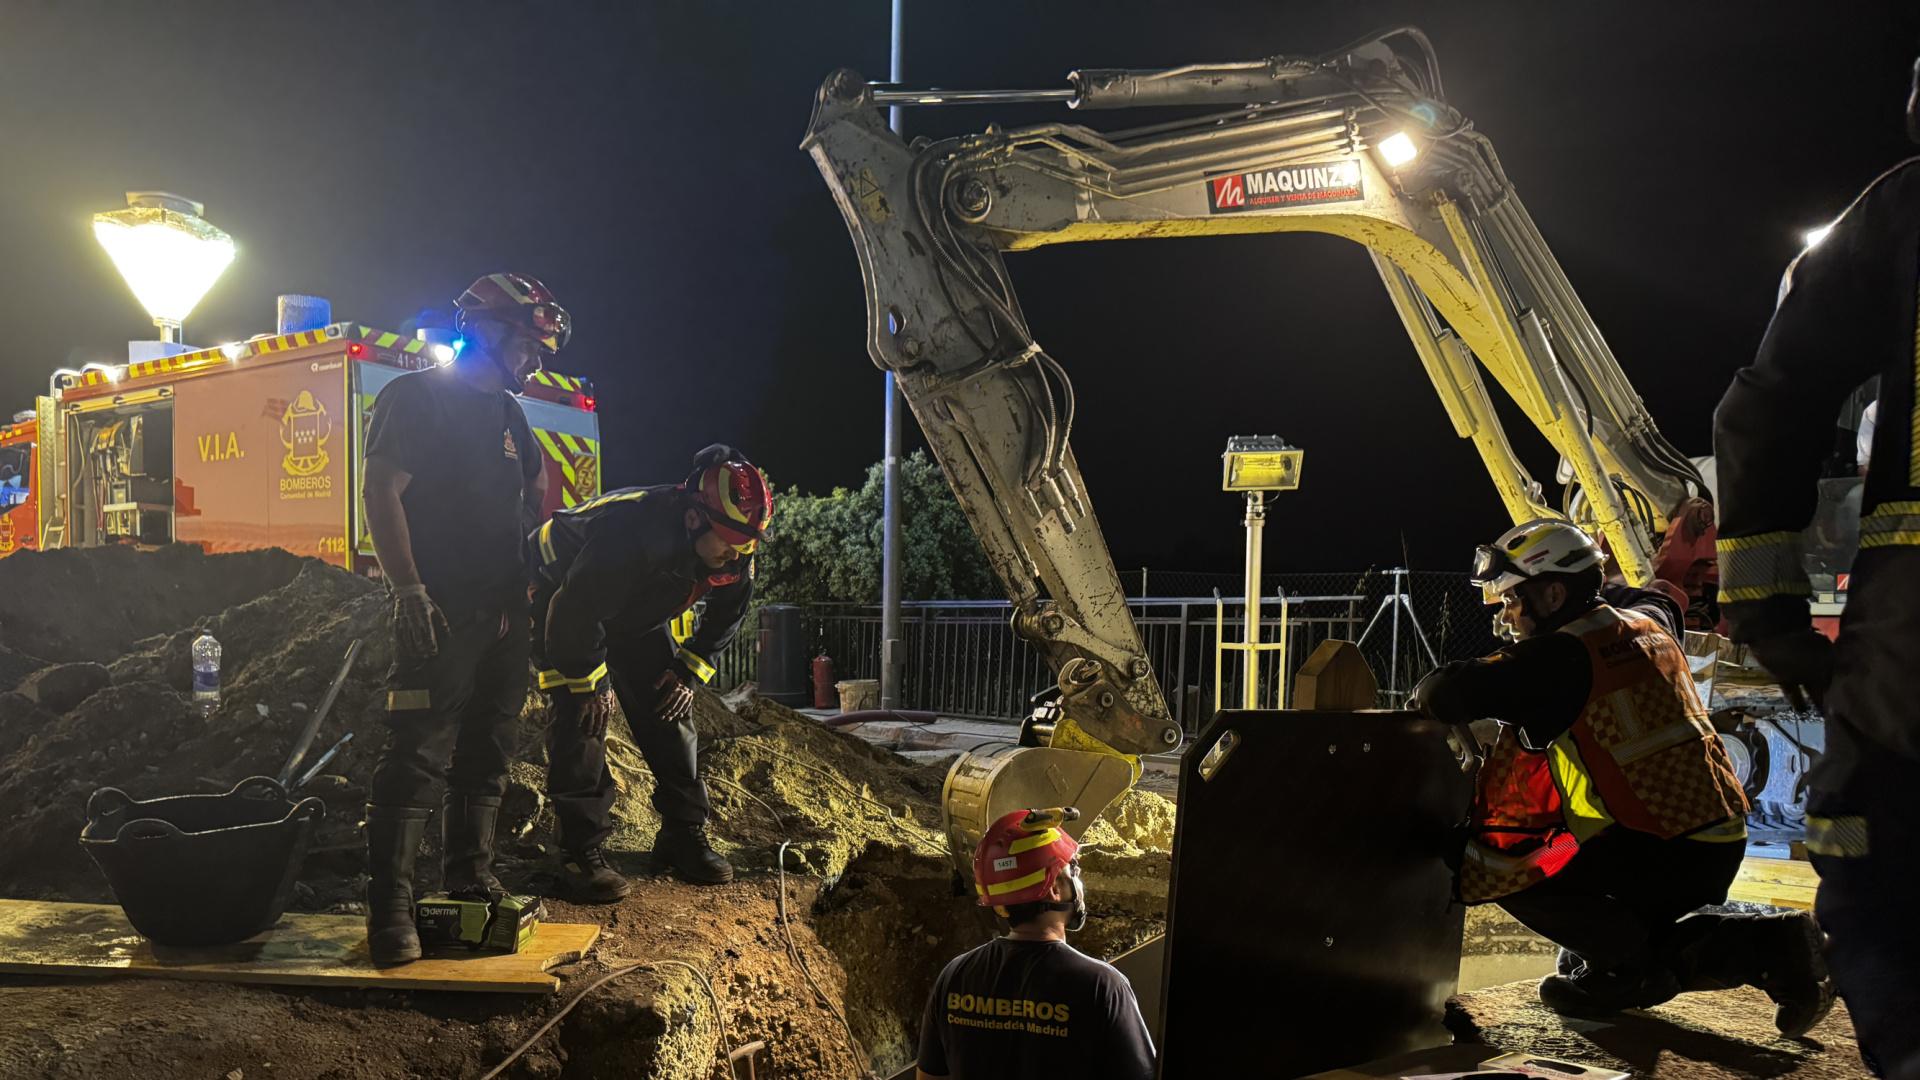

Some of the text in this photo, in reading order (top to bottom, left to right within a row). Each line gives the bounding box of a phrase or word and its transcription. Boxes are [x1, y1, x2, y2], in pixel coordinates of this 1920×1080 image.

[1250, 195, 1280, 205] ALQUILER
[1280, 194, 1286, 202] Y
[1286, 192, 1307, 202] VENTA
[1308, 191, 1317, 200] DE
[198, 432, 245, 462] V.I.A.
[280, 476, 331, 491] BOMBEROS
[326, 536, 345, 553] 112
[947, 992, 1070, 1022] BOMBEROS
[1027, 1022, 1068, 1037] Madrid
